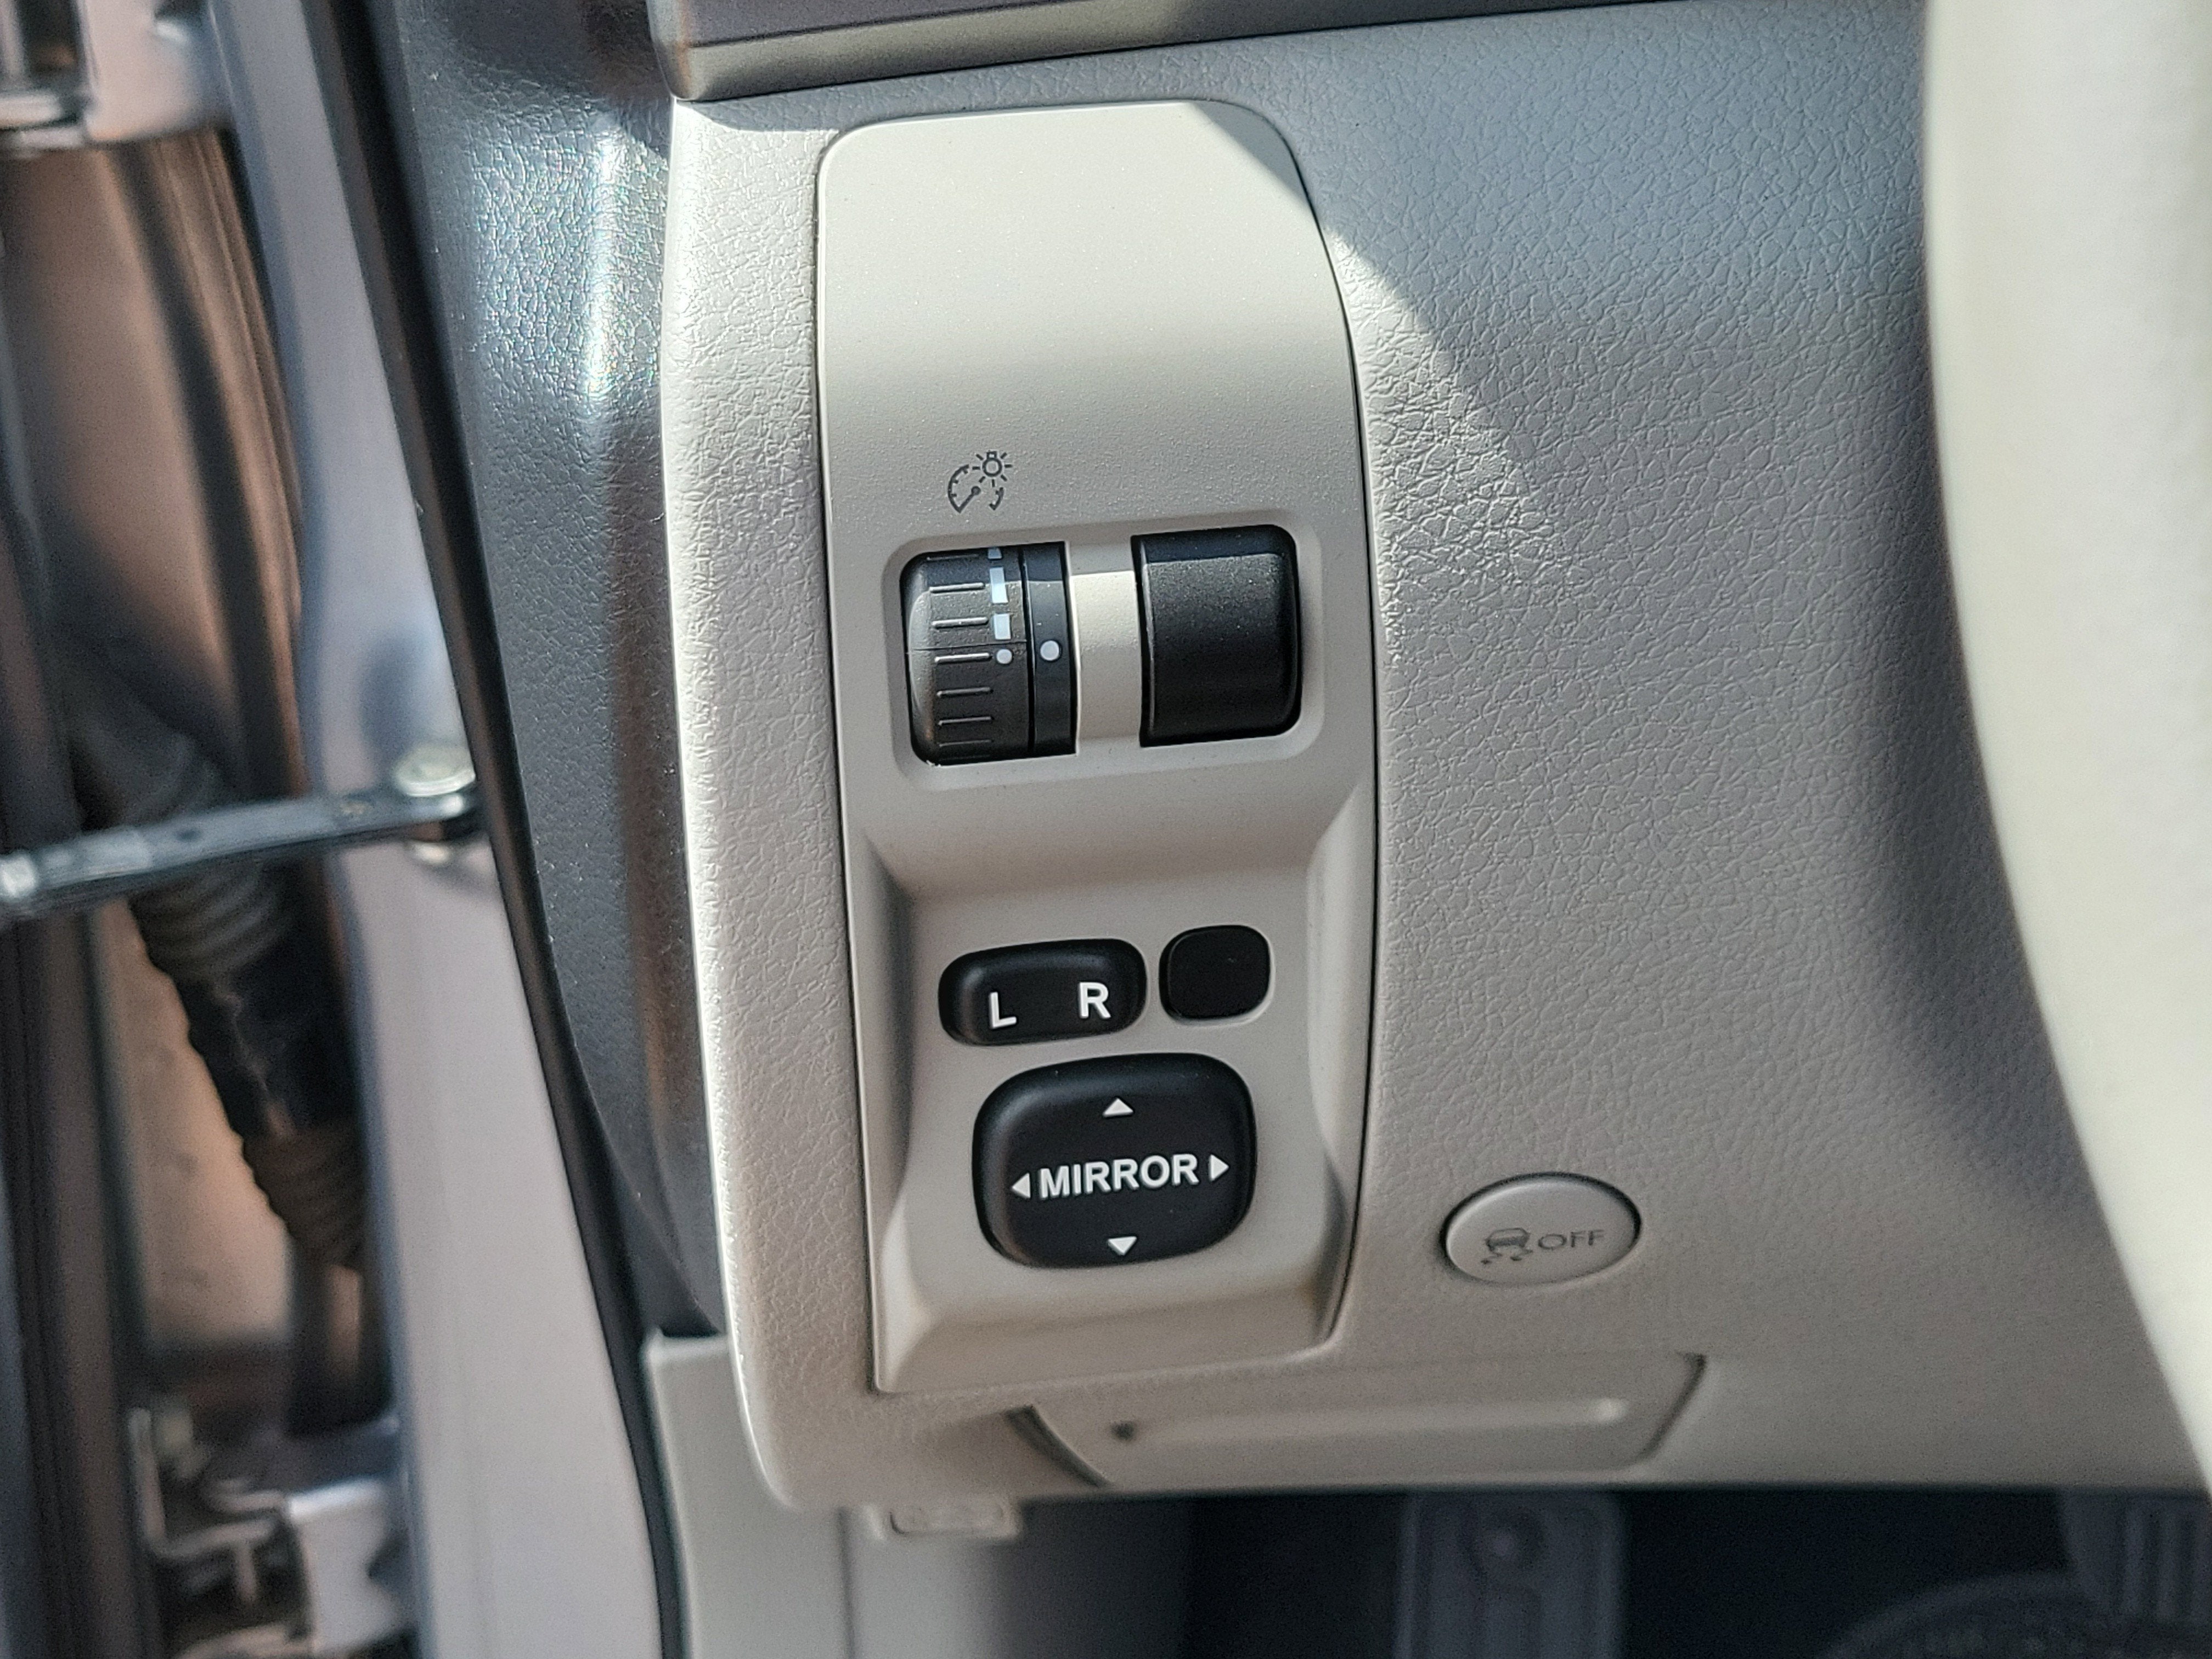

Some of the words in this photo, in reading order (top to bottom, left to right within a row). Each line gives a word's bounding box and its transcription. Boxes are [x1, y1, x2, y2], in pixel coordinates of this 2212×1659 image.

[989, 992, 1017, 1029] L
[1079, 981, 1110, 1018] R
[1040, 1153, 1199, 1199] MIRROR
[1538, 1229, 1605, 1250] OFF
